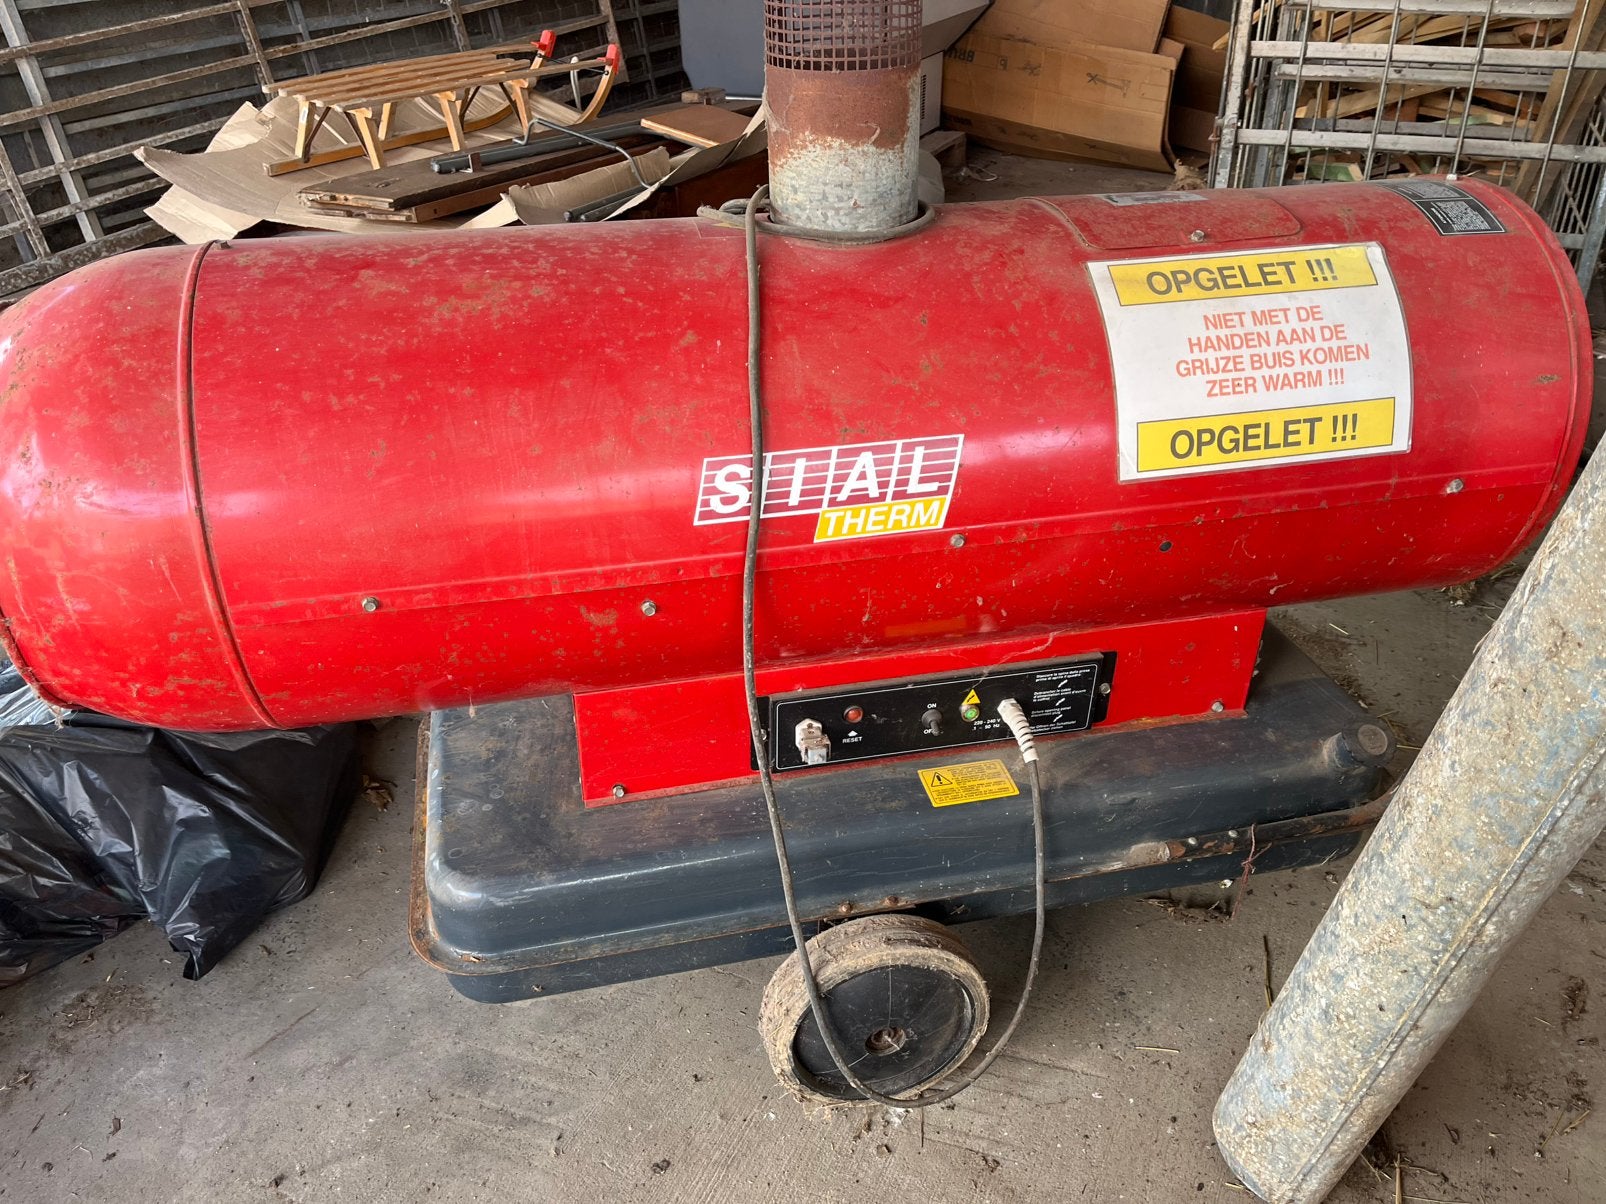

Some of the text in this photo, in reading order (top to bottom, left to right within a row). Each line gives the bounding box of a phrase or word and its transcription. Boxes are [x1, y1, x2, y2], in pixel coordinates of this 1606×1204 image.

[1146, 258, 1338, 295] OPGELET !!!
[1203, 305, 1324, 331] NIET MET DE
[1187, 324, 1347, 353] HANDEN AAN DE
[1175, 343, 1370, 378] GRIJZE BUIS KOMEN
[1206, 368, 1345, 398] ZEER WARM !!!
[1170, 413, 1358, 459] OPGELET !!!
[710, 446, 939, 514] SIAL
[823, 501, 940, 537] THERM
[842, 736, 863, 744] RESET
